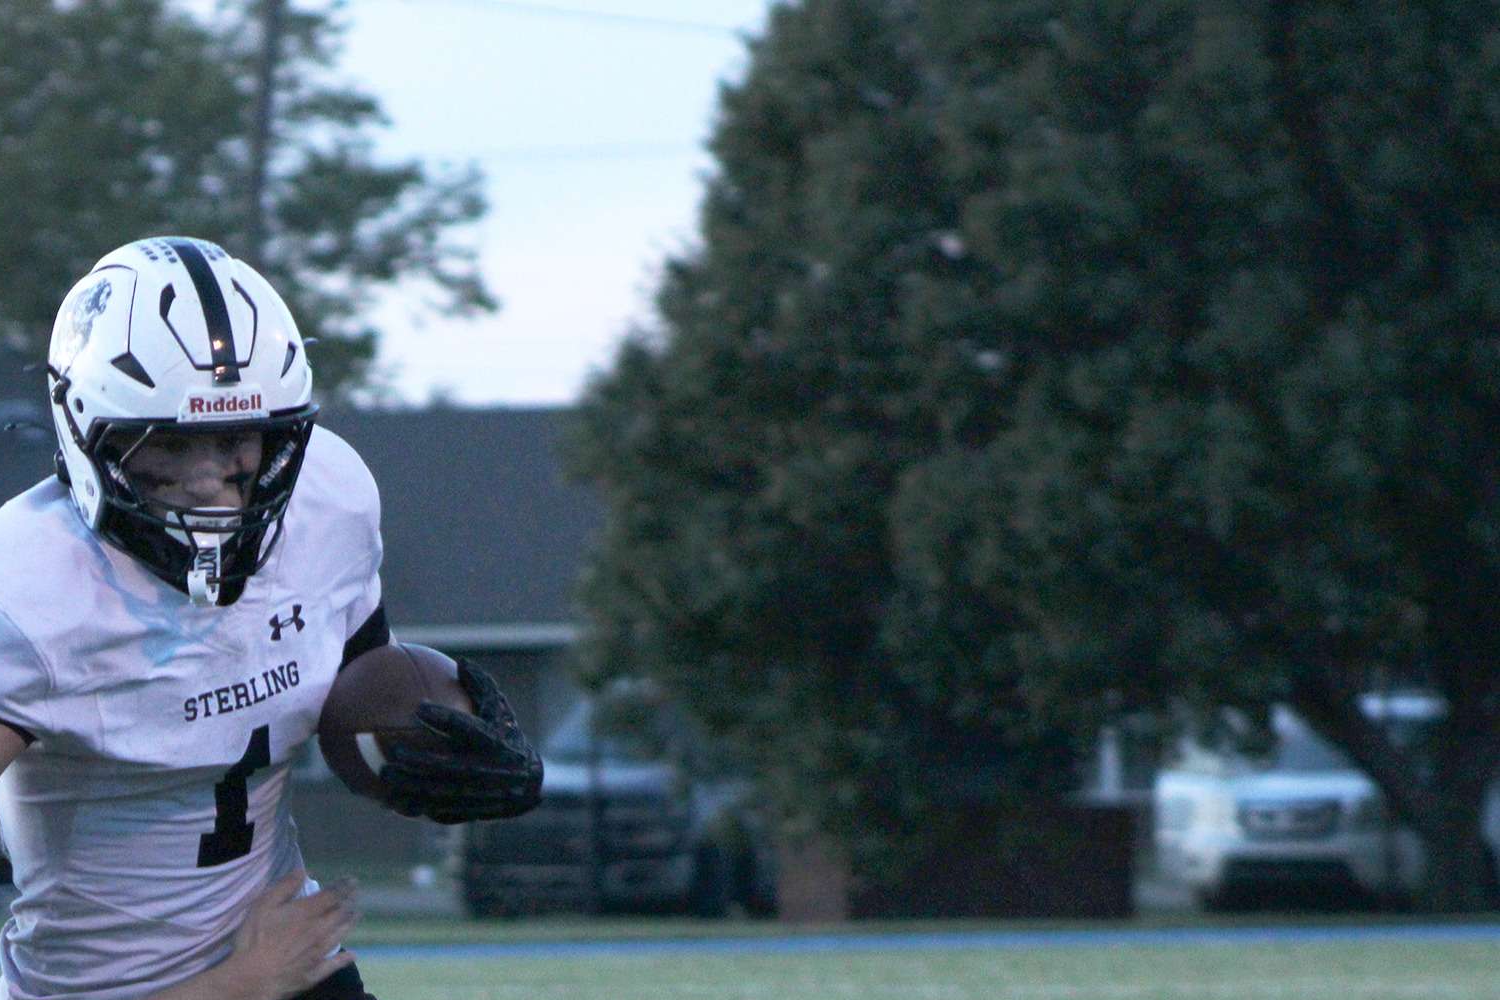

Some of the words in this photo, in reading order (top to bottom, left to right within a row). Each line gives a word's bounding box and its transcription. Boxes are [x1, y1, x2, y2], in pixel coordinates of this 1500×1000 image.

[189, 393, 262, 414] Riddell
[183, 660, 301, 722] STERLING
[196, 724, 271, 869] 1
